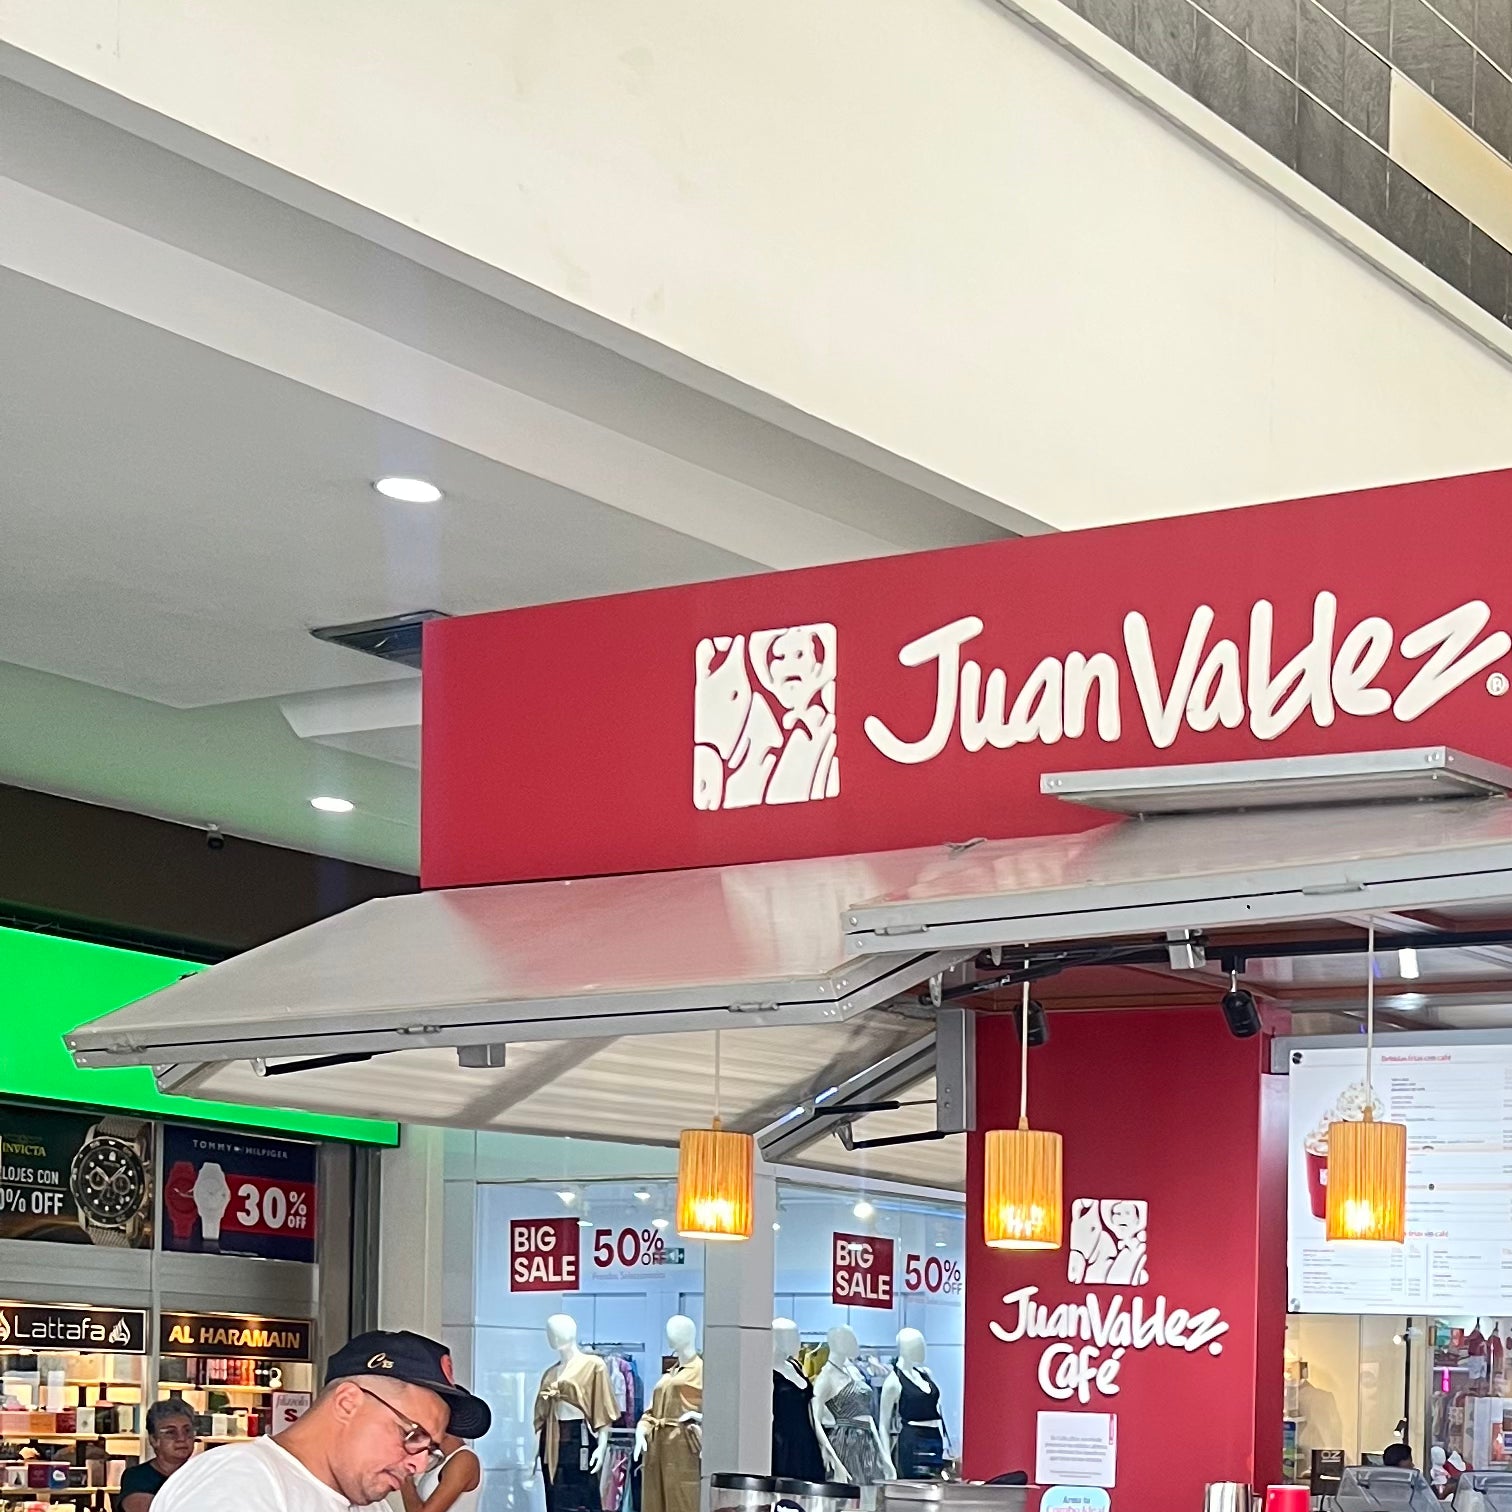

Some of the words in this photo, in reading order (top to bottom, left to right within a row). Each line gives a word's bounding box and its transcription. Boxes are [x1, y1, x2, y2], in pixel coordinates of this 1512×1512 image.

[865, 616, 1121, 762] Juan
[1121, 591, 1510, 747] Valdez
[2, 1142, 46, 1157] INVICTA
[193, 1139, 231, 1153] TOMMY
[245, 1146, 288, 1160] HILFIGER
[2, 1166, 33, 1183] LOJES
[37, 1169, 59, 1185] CON
[0, 1187, 26, 1213] 0%
[31, 1191, 63, 1215] OFF
[236, 1183, 307, 1229] 30%
[287, 1215, 307, 1229] OFF
[514, 1226, 556, 1253] BIG
[593, 1227, 665, 1268] 50%
[836, 1240, 874, 1268] BIG
[514, 1255, 576, 1283] SALE
[905, 1254, 961, 1293] 50%
[836, 1270, 890, 1300] SALE
[943, 1281, 963, 1295] OFF
[14, 1315, 105, 1340] Lattafa
[989, 1286, 1090, 1342] Juan
[1086, 1293, 1229, 1352] Valdez
[169, 1325, 194, 1344] AL
[200, 1327, 300, 1349] HARAMAIN
[1038, 1343, 1125, 1403] Café
